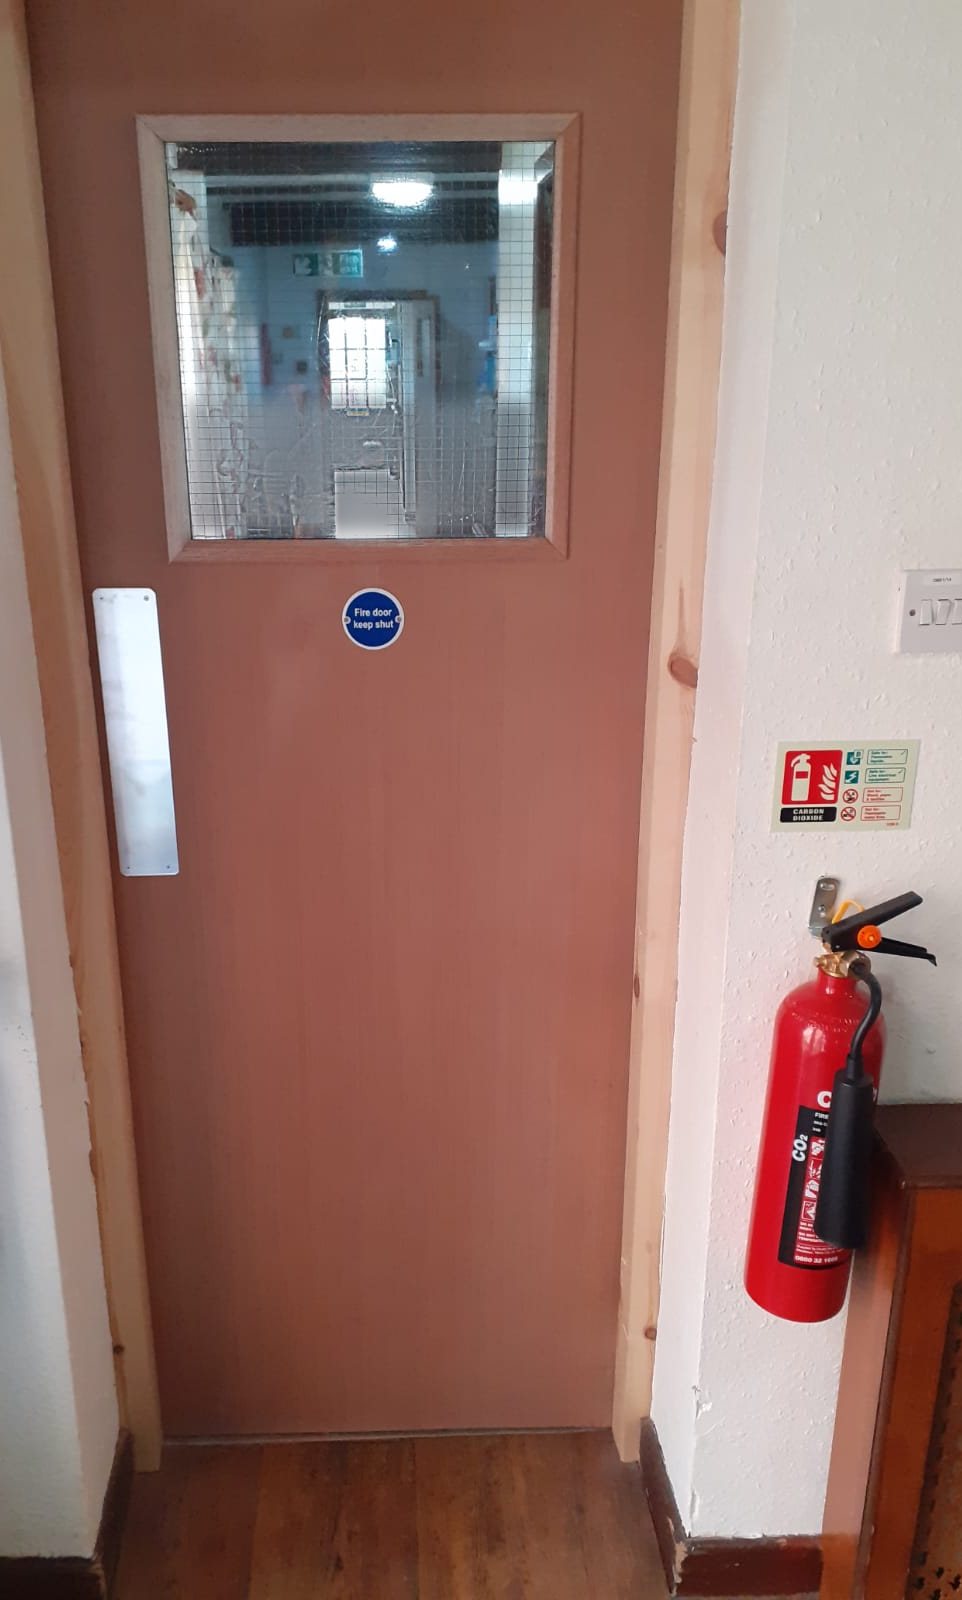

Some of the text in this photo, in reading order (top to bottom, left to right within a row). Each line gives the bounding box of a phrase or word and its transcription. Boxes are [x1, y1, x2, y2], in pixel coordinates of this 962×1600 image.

[354, 608, 392, 617] Fire door
[353, 619, 394, 631] keep shut
